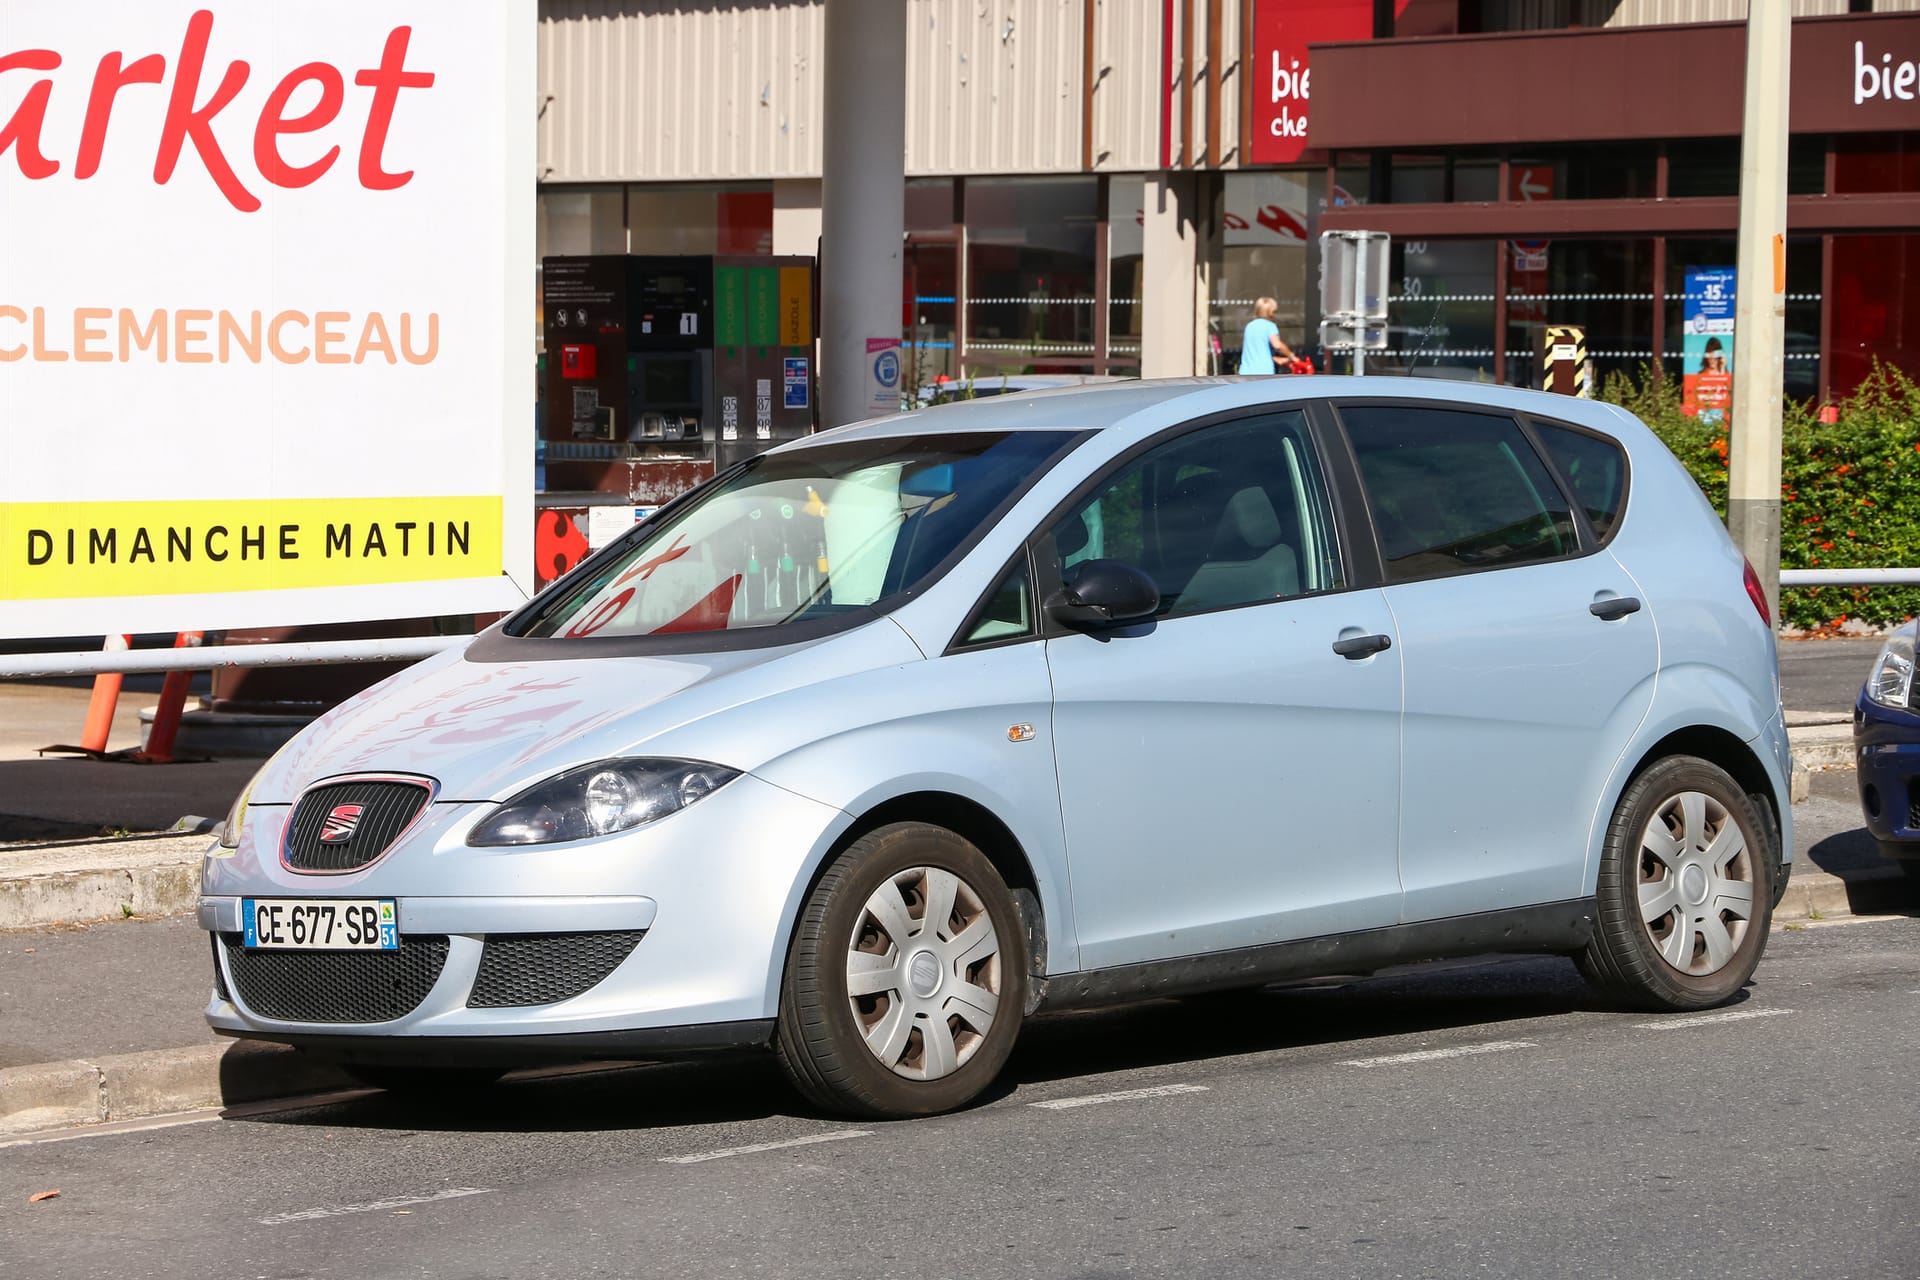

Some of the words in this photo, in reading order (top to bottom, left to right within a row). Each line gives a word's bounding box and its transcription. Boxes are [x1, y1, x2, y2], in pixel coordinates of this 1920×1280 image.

[1855, 40, 1920, 104] bie
[1270, 105, 1308, 137] che
[0, 305, 440, 365] CLEMENCEAU
[723, 398, 737, 412] 85
[757, 397, 771, 411] 87
[723, 419, 737, 432] 95
[757, 419, 771, 432] 98
[27, 525, 300, 565] DIMANCHE
[325, 521, 471, 560] MATIN
[382, 927, 396, 946] 51
